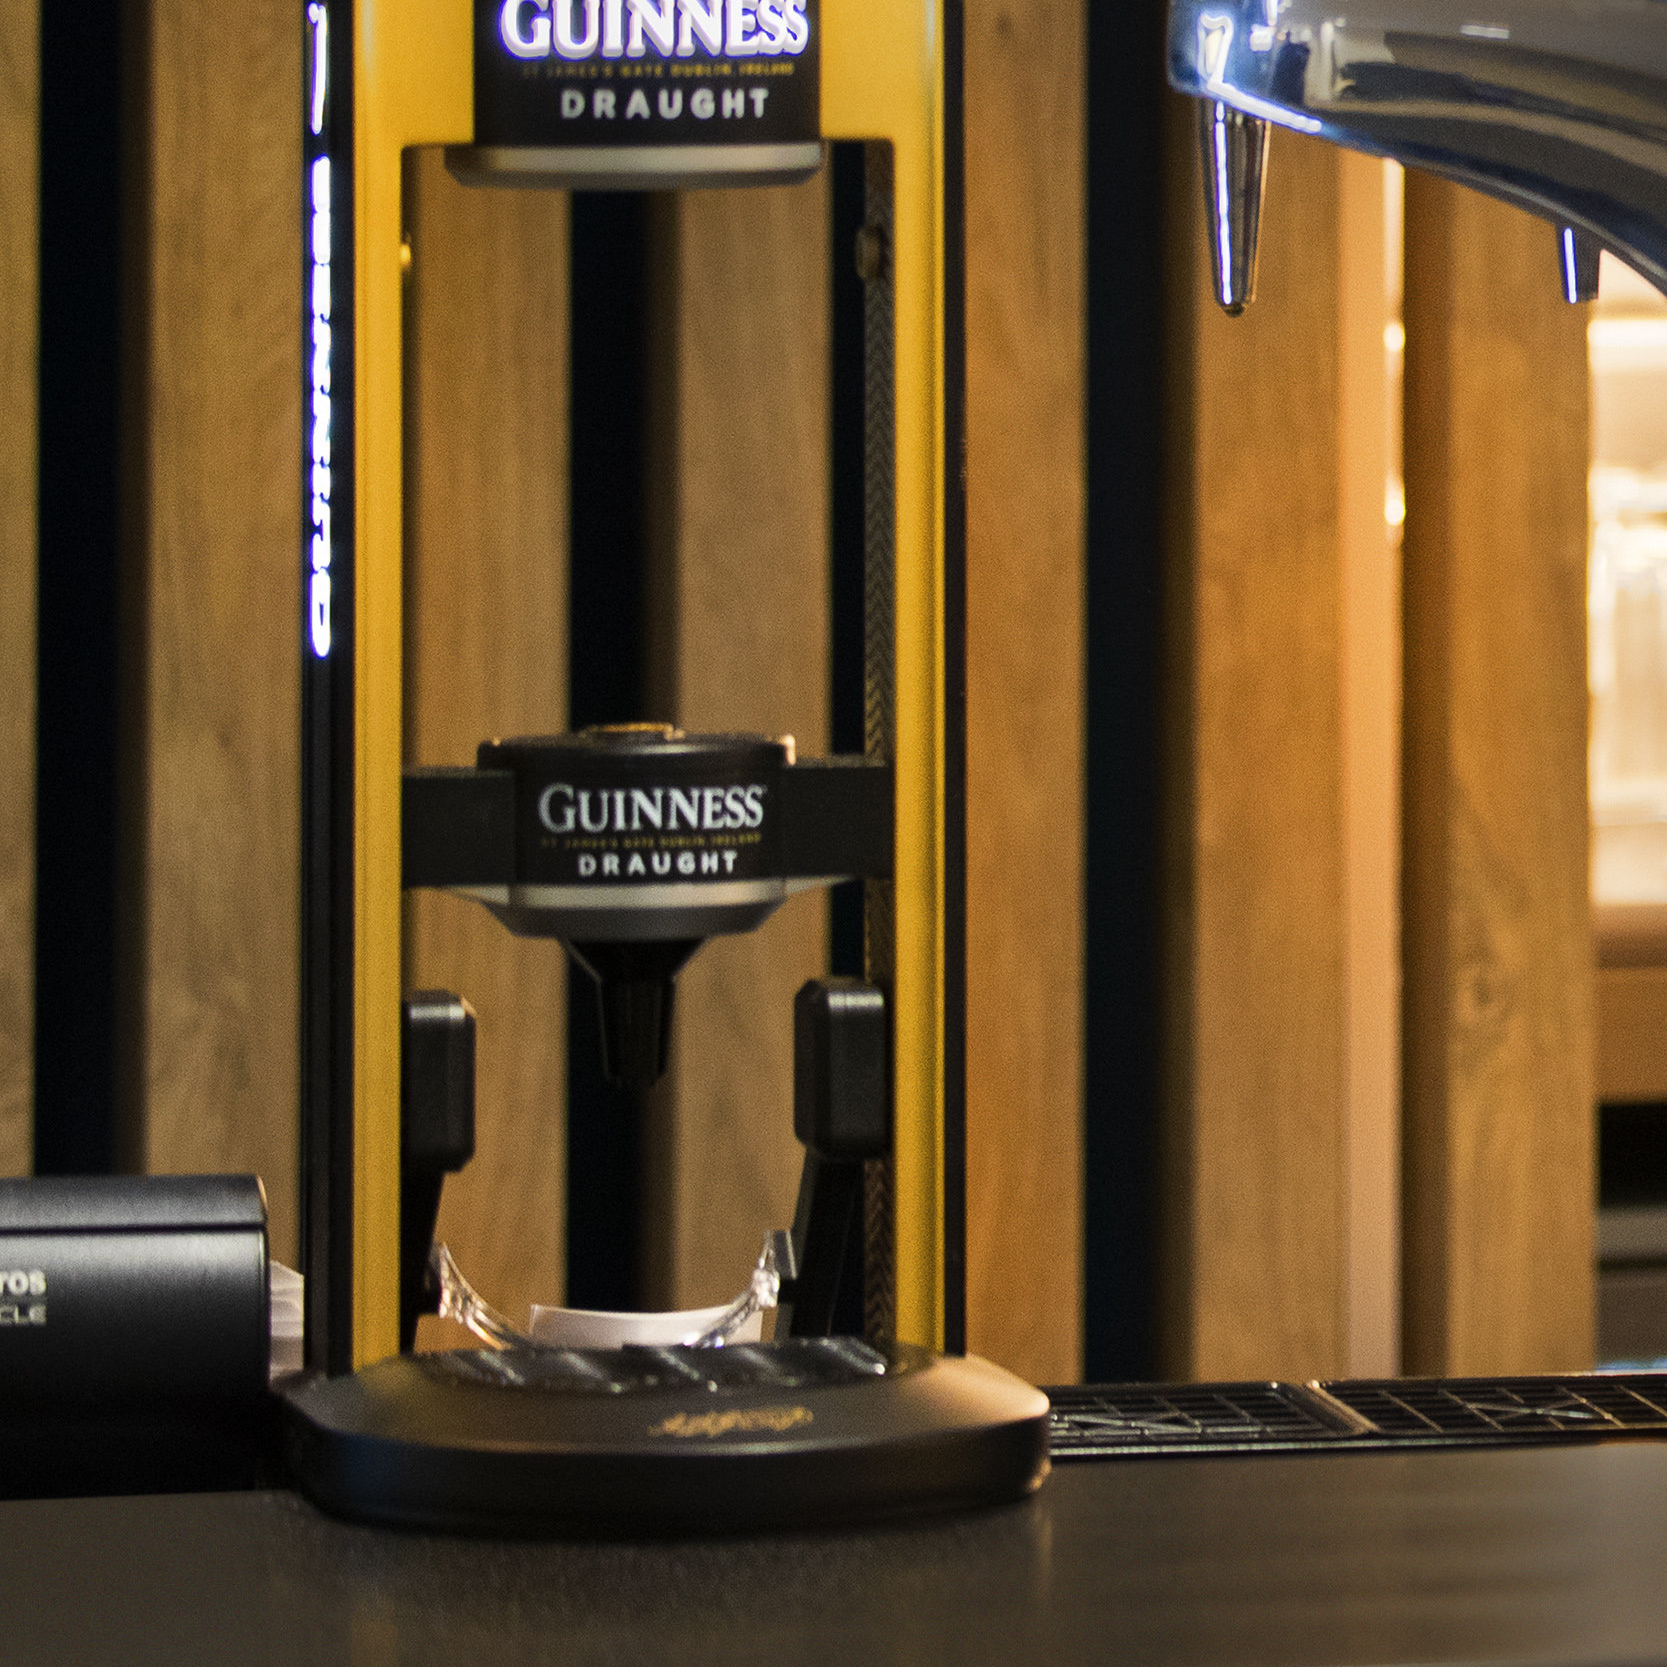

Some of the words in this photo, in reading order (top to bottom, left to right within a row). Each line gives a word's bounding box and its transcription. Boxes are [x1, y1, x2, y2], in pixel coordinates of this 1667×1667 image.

[560, 87, 769, 120] DRAUGHT
[538, 781, 764, 833] GUINNESS
[577, 850, 738, 876] DRAUGHT
